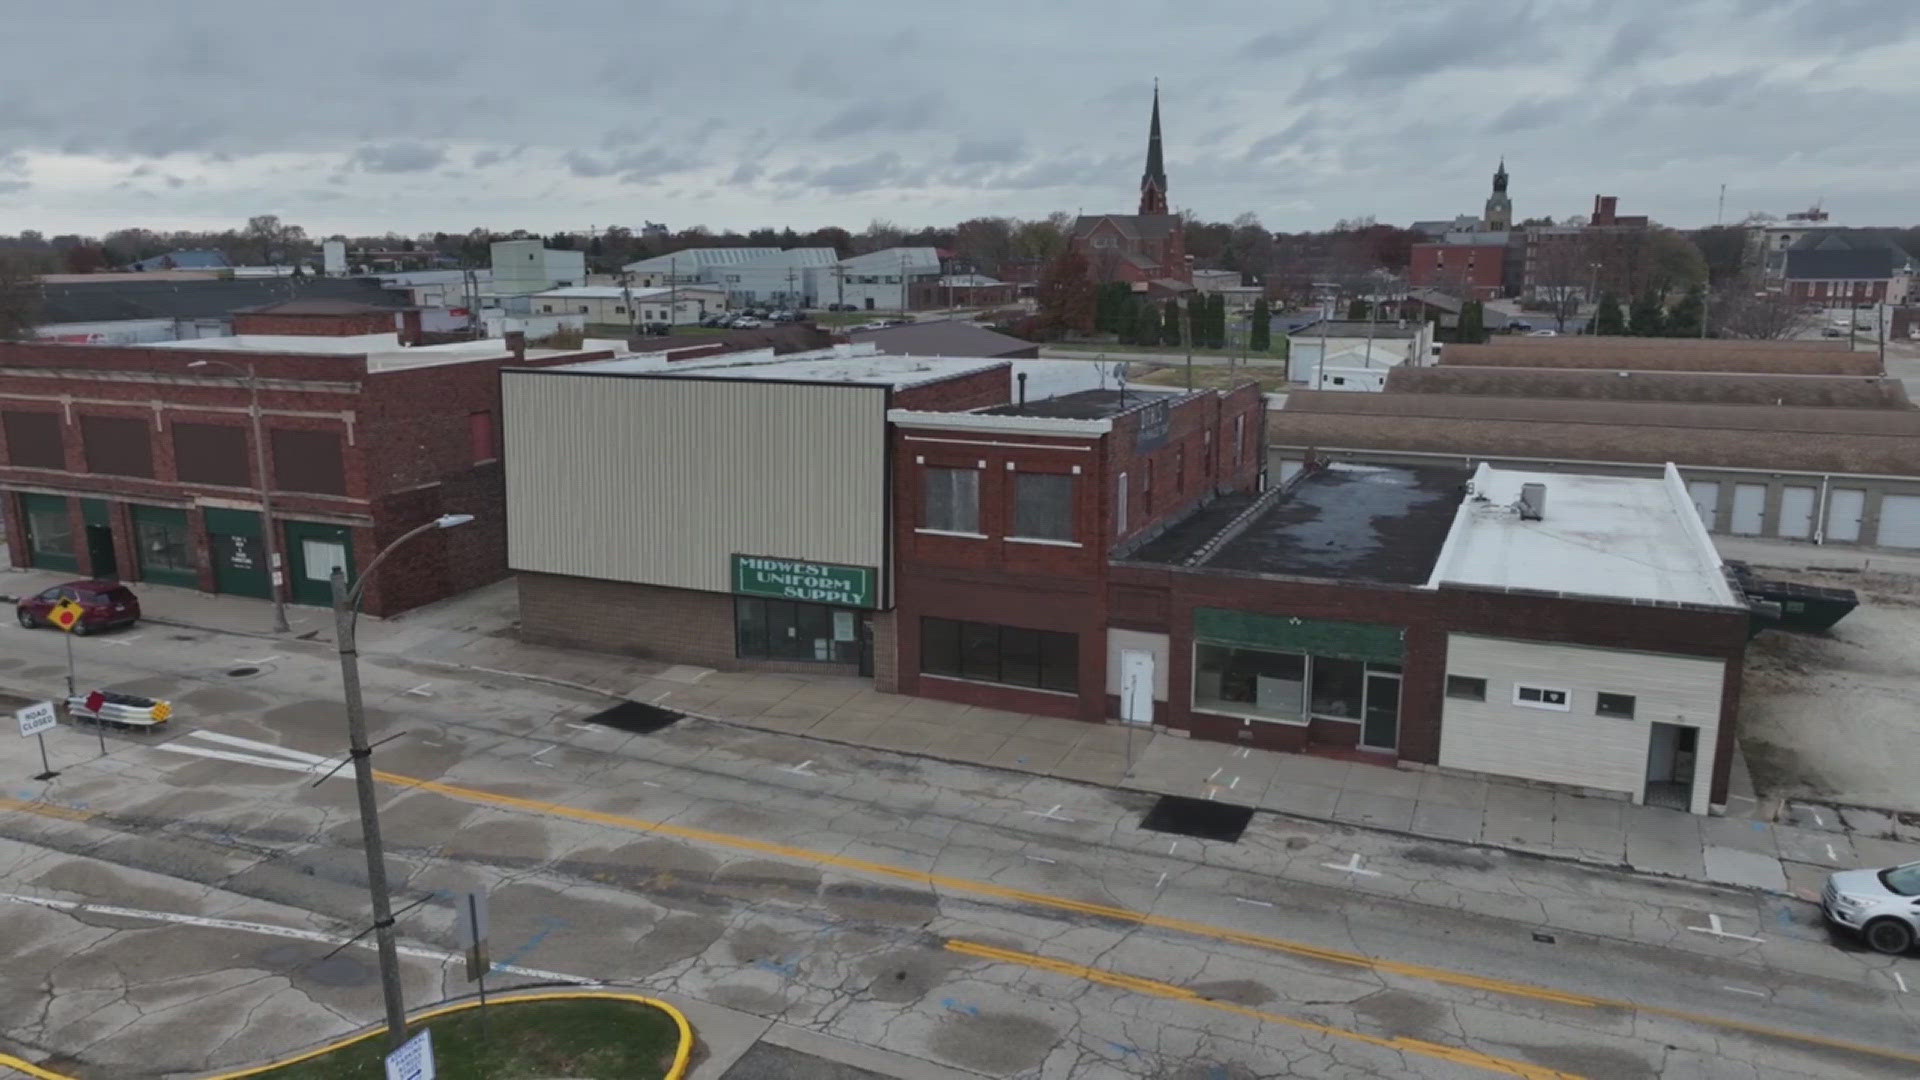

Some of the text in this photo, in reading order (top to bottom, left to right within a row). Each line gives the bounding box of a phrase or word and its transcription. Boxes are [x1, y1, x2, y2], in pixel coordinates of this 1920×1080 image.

[740, 558, 829, 576] MIDWEST
[757, 571, 851, 591] UNIFORM
[784, 586, 862, 605] SUPPLY
[23, 715, 53, 731] CLOSED
[25, 708, 47, 721] ROAD
